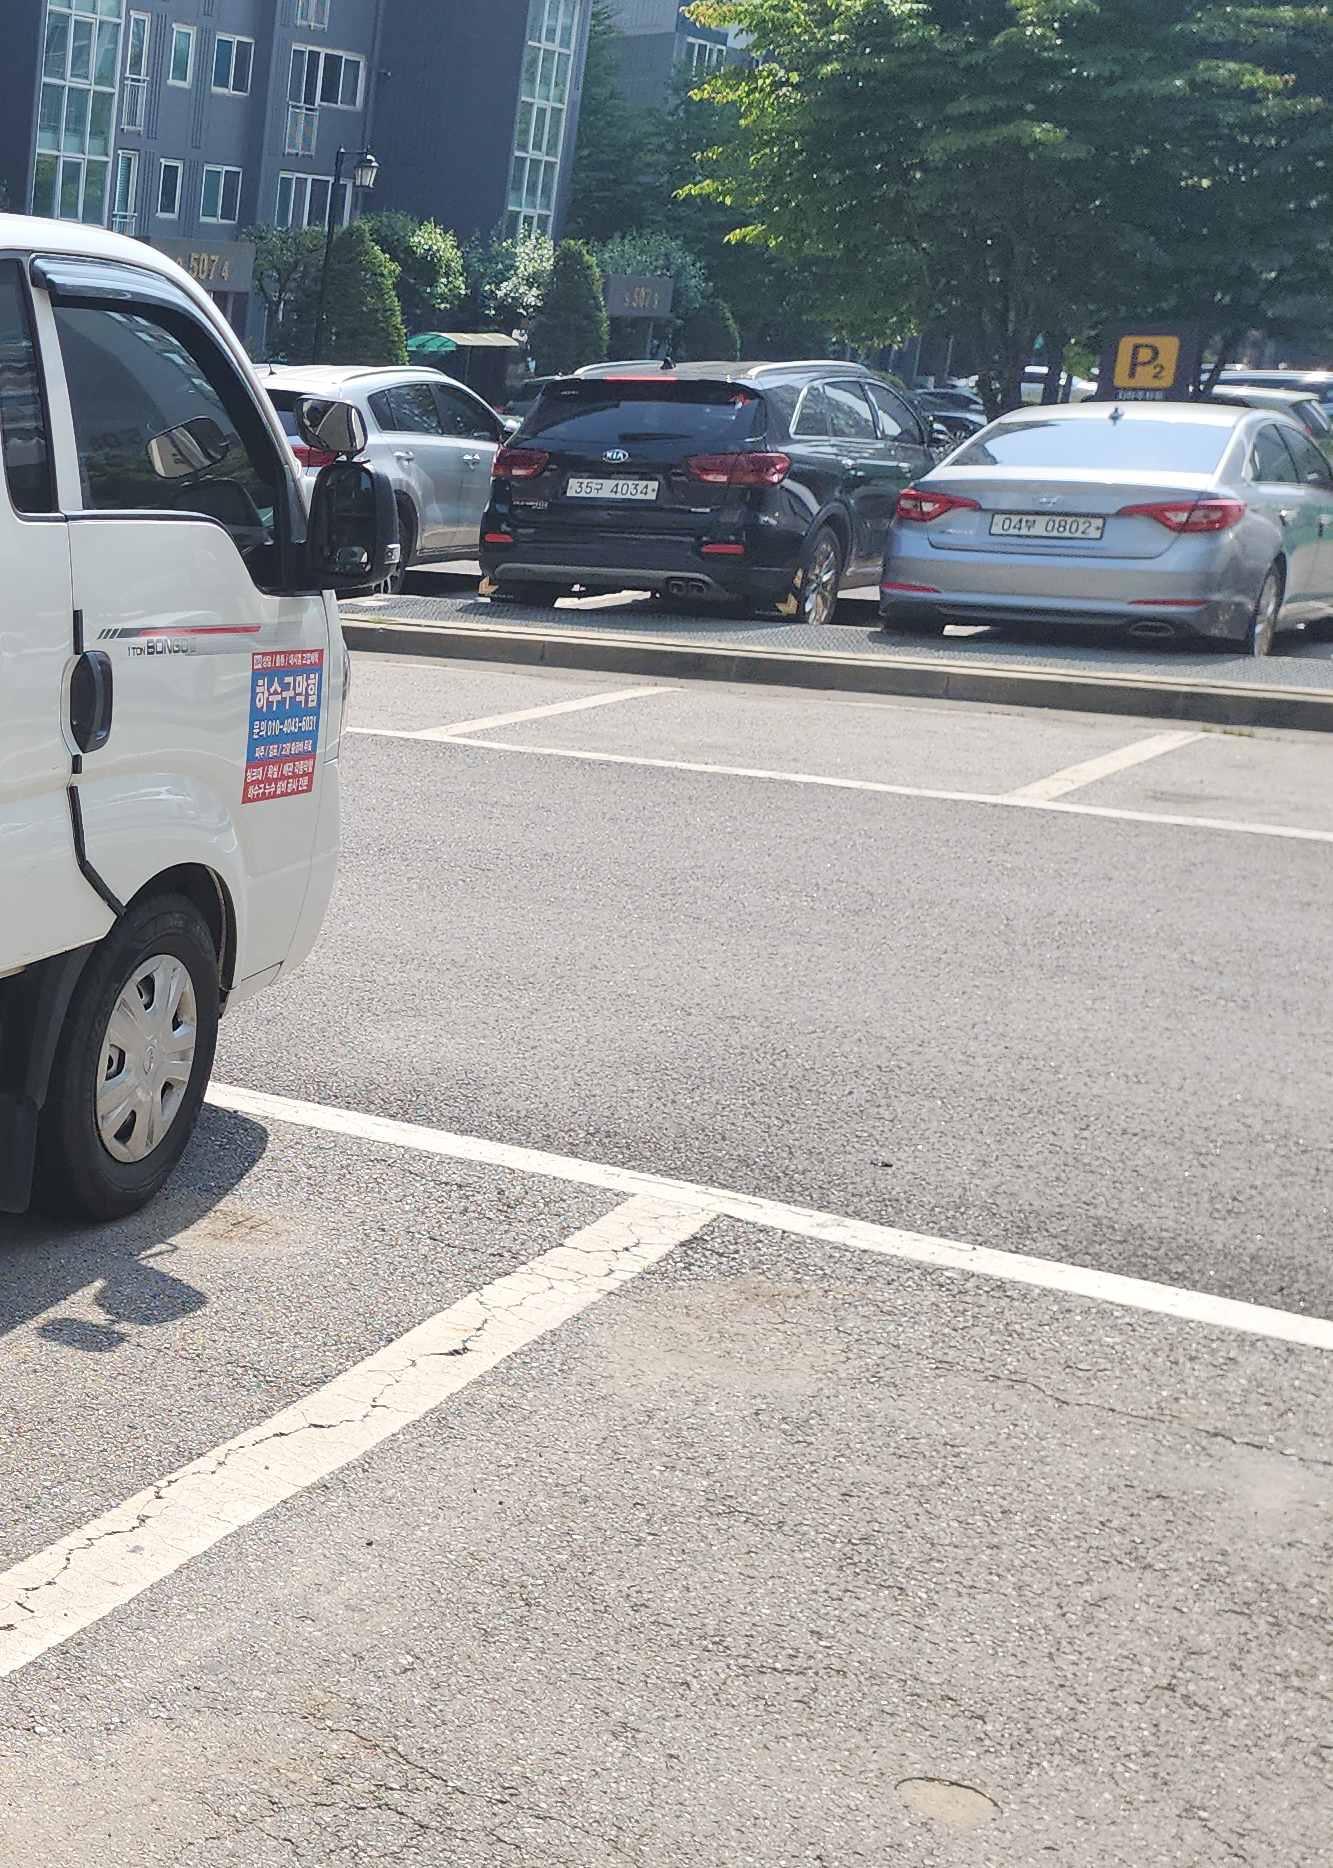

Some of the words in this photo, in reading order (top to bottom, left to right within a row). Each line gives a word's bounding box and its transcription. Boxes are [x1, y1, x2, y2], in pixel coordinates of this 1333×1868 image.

[189, 252, 219, 280] 507
[574, 481, 603, 494] 35구
[610, 483, 649, 496] 4034
[1045, 519, 1092, 534] 0802
[256, 672, 319, 713] 하수구막힘
[253, 720, 267, 738] 문의
[267, 715, 316, 736] 010-4043-6031
